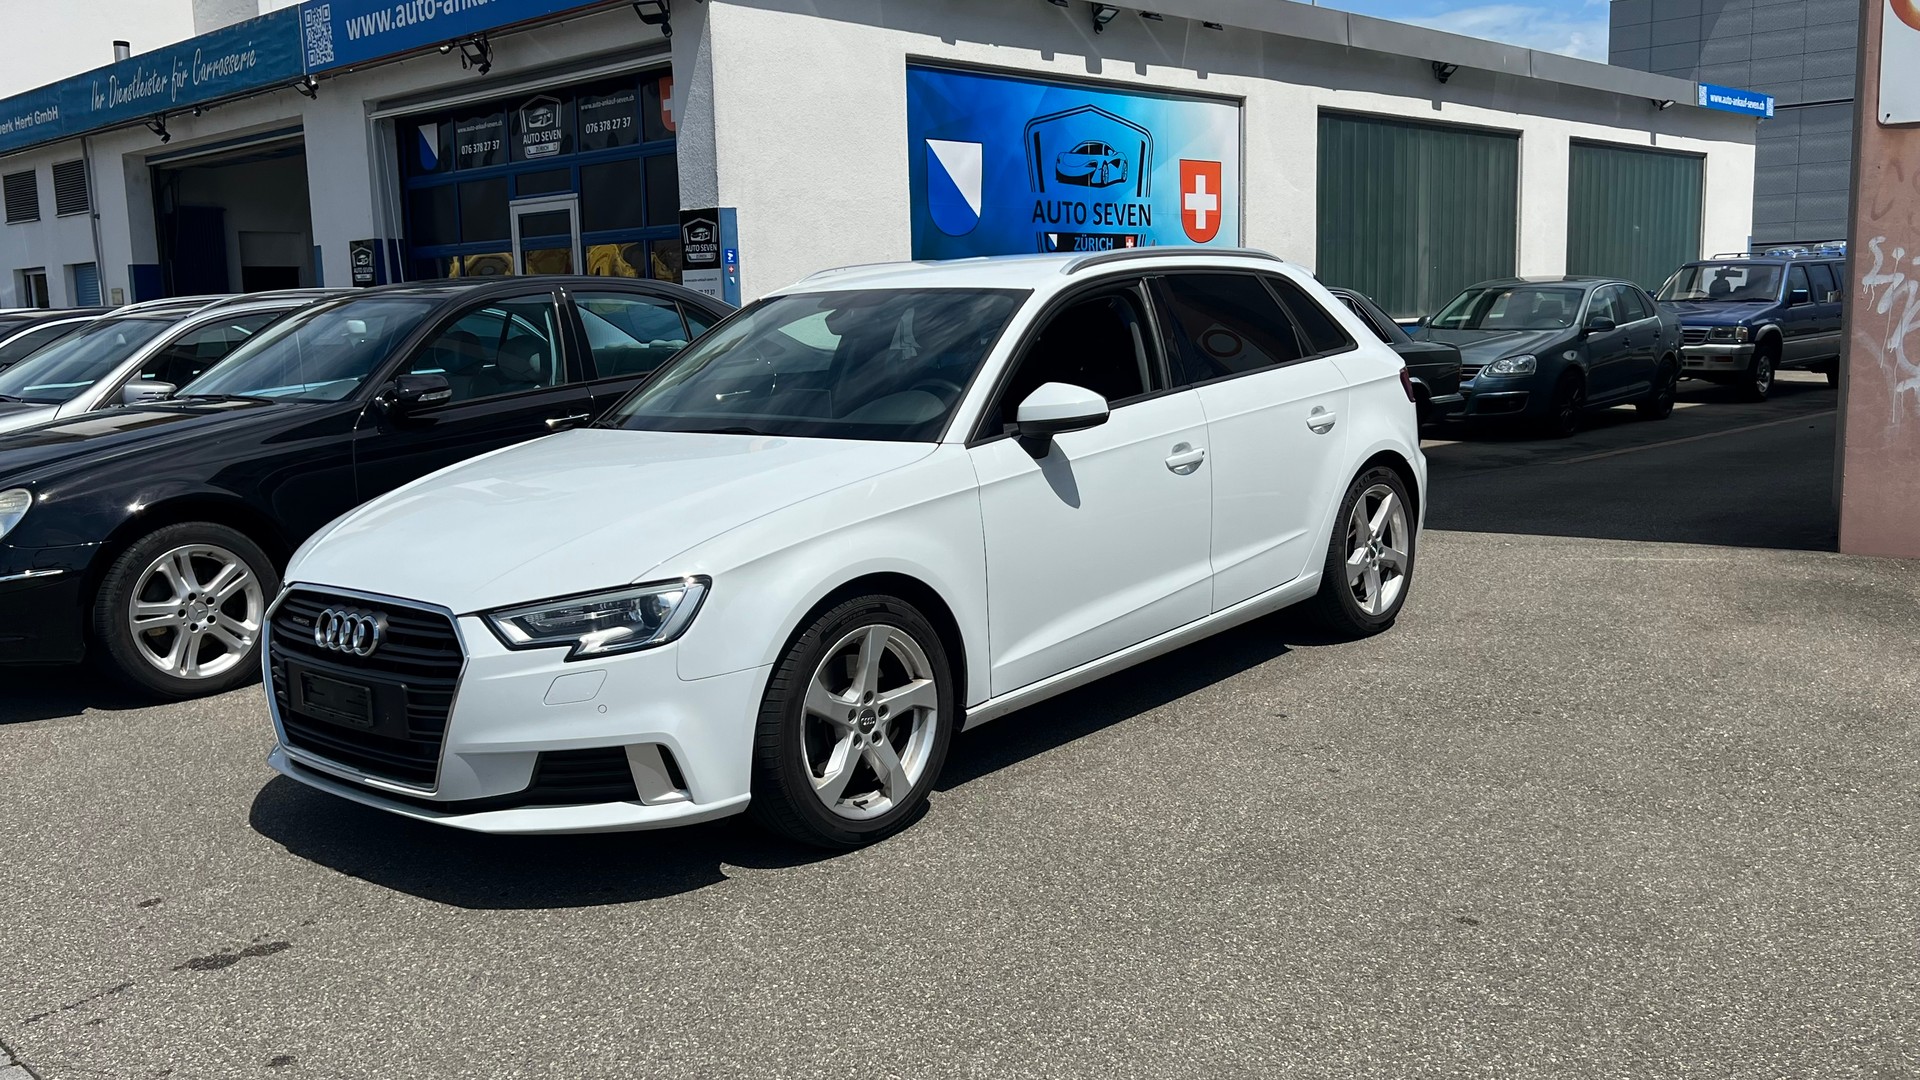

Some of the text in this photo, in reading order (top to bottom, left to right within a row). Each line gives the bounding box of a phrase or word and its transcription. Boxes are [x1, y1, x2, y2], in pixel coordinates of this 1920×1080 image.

[91, 41, 258, 112] Ihr Dienstleister für Carrosserie
[0, 105, 59, 135] erk Herti GmbH
[585, 116, 631, 134] 076 378 27 37
[522, 129, 562, 145] AUTO SEVEN
[461, 139, 500, 155] 076 378 27 37
[1032, 199, 1152, 227] AUTO SEVEN
[685, 243, 717, 252] AUTO SEVEN
[1073, 234, 1114, 252] ZÜRICH
